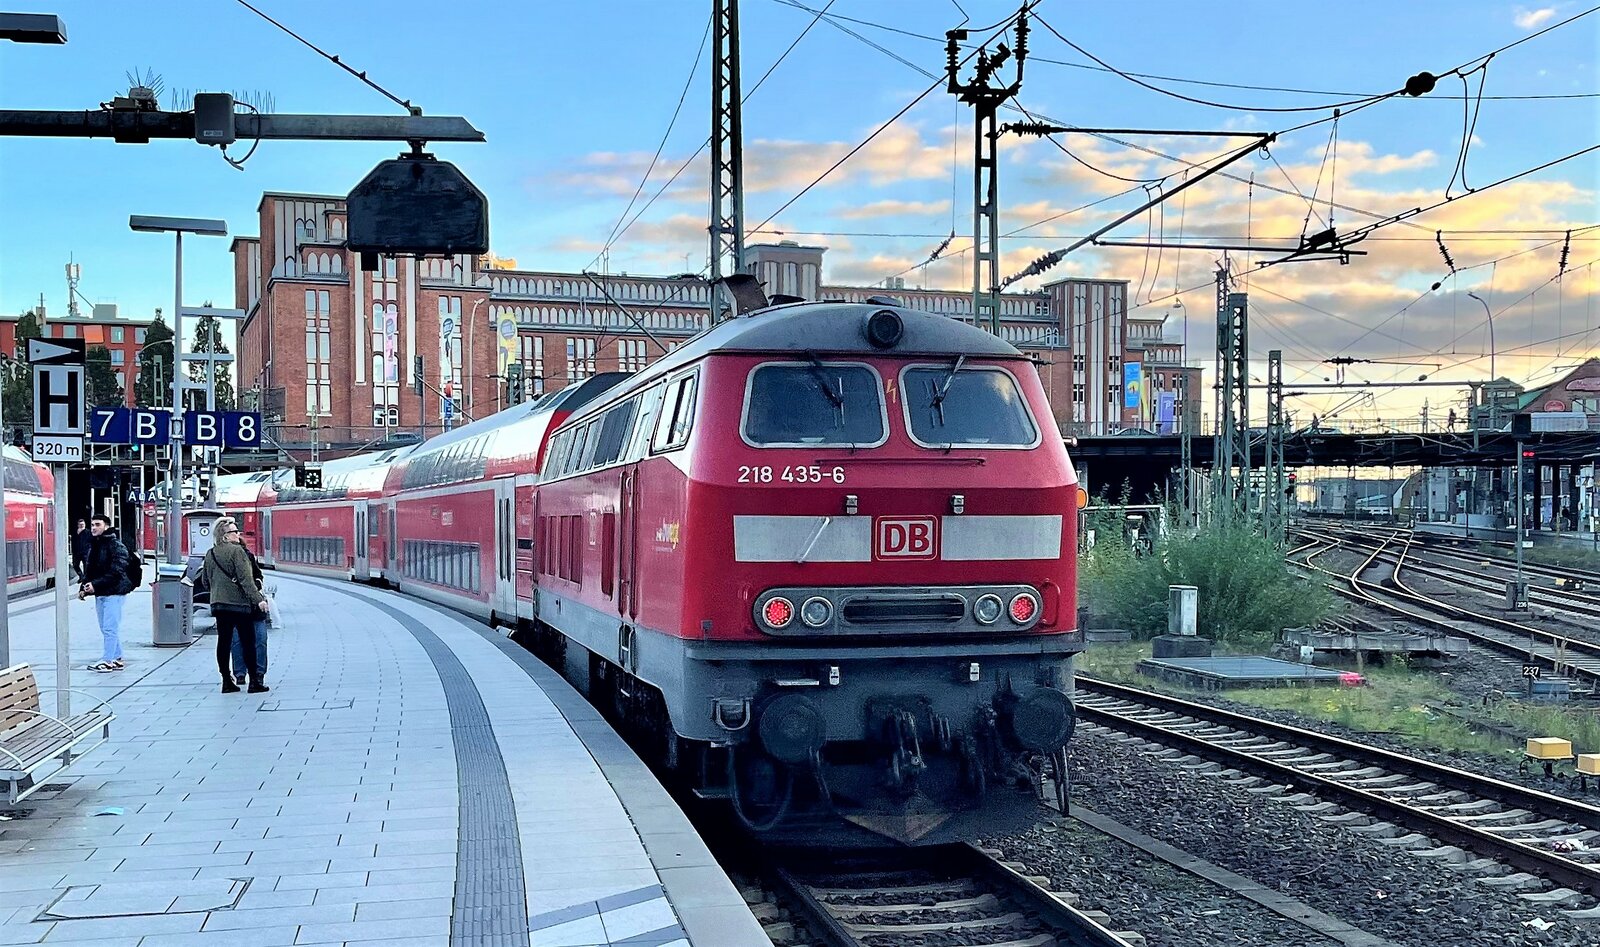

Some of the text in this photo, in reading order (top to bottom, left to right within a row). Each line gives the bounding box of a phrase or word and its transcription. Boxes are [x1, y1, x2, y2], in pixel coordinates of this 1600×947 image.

[39, 370, 79, 429] H
[96, 410, 157, 439] 7 B
[197, 414, 256, 442] B 8
[36, 442, 80, 456] 320 m
[737, 465, 846, 484] 218 435-6
[128, 490, 137, 501] A
[148, 491, 156, 501] A
[883, 522, 931, 553] DB
[1523, 666, 1540, 676] 237
